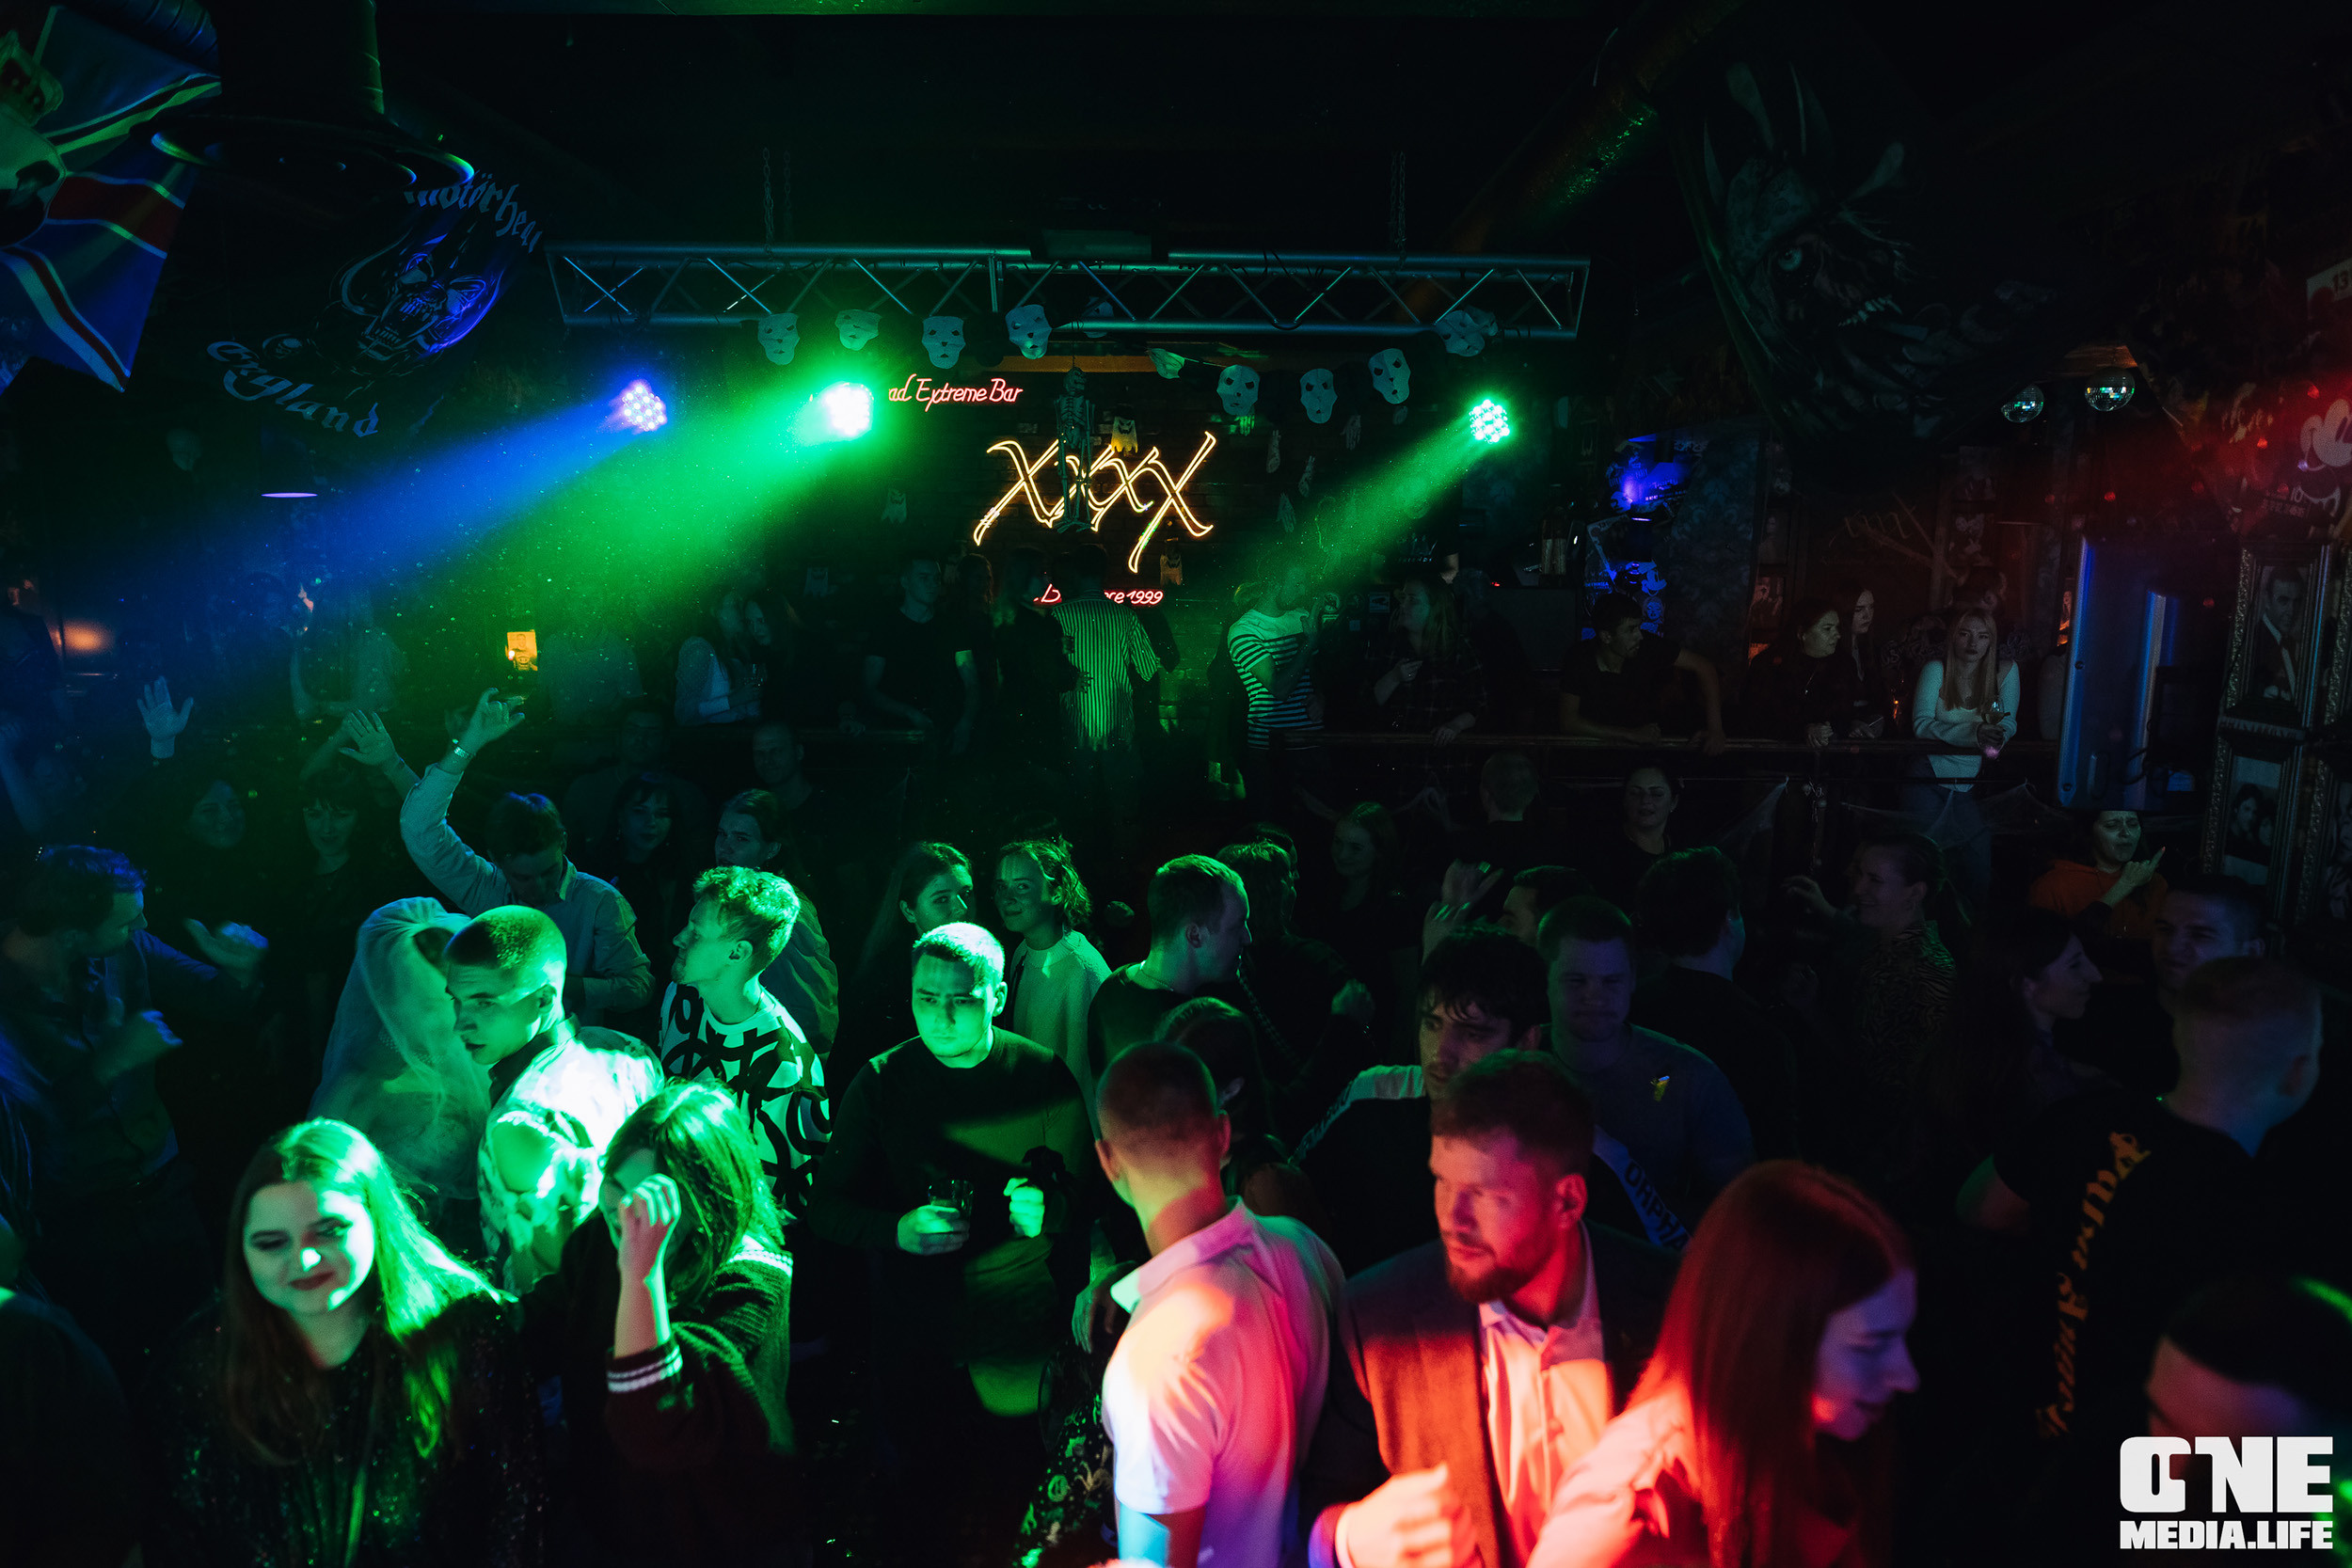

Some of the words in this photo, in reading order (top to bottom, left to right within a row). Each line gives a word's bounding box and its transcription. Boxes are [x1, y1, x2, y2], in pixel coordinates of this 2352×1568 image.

[888, 373, 913, 402] ad
[915, 377, 988, 412] Extreme
[988, 377, 1024, 403] Bar
[1126, 590, 1164, 605] 1999
